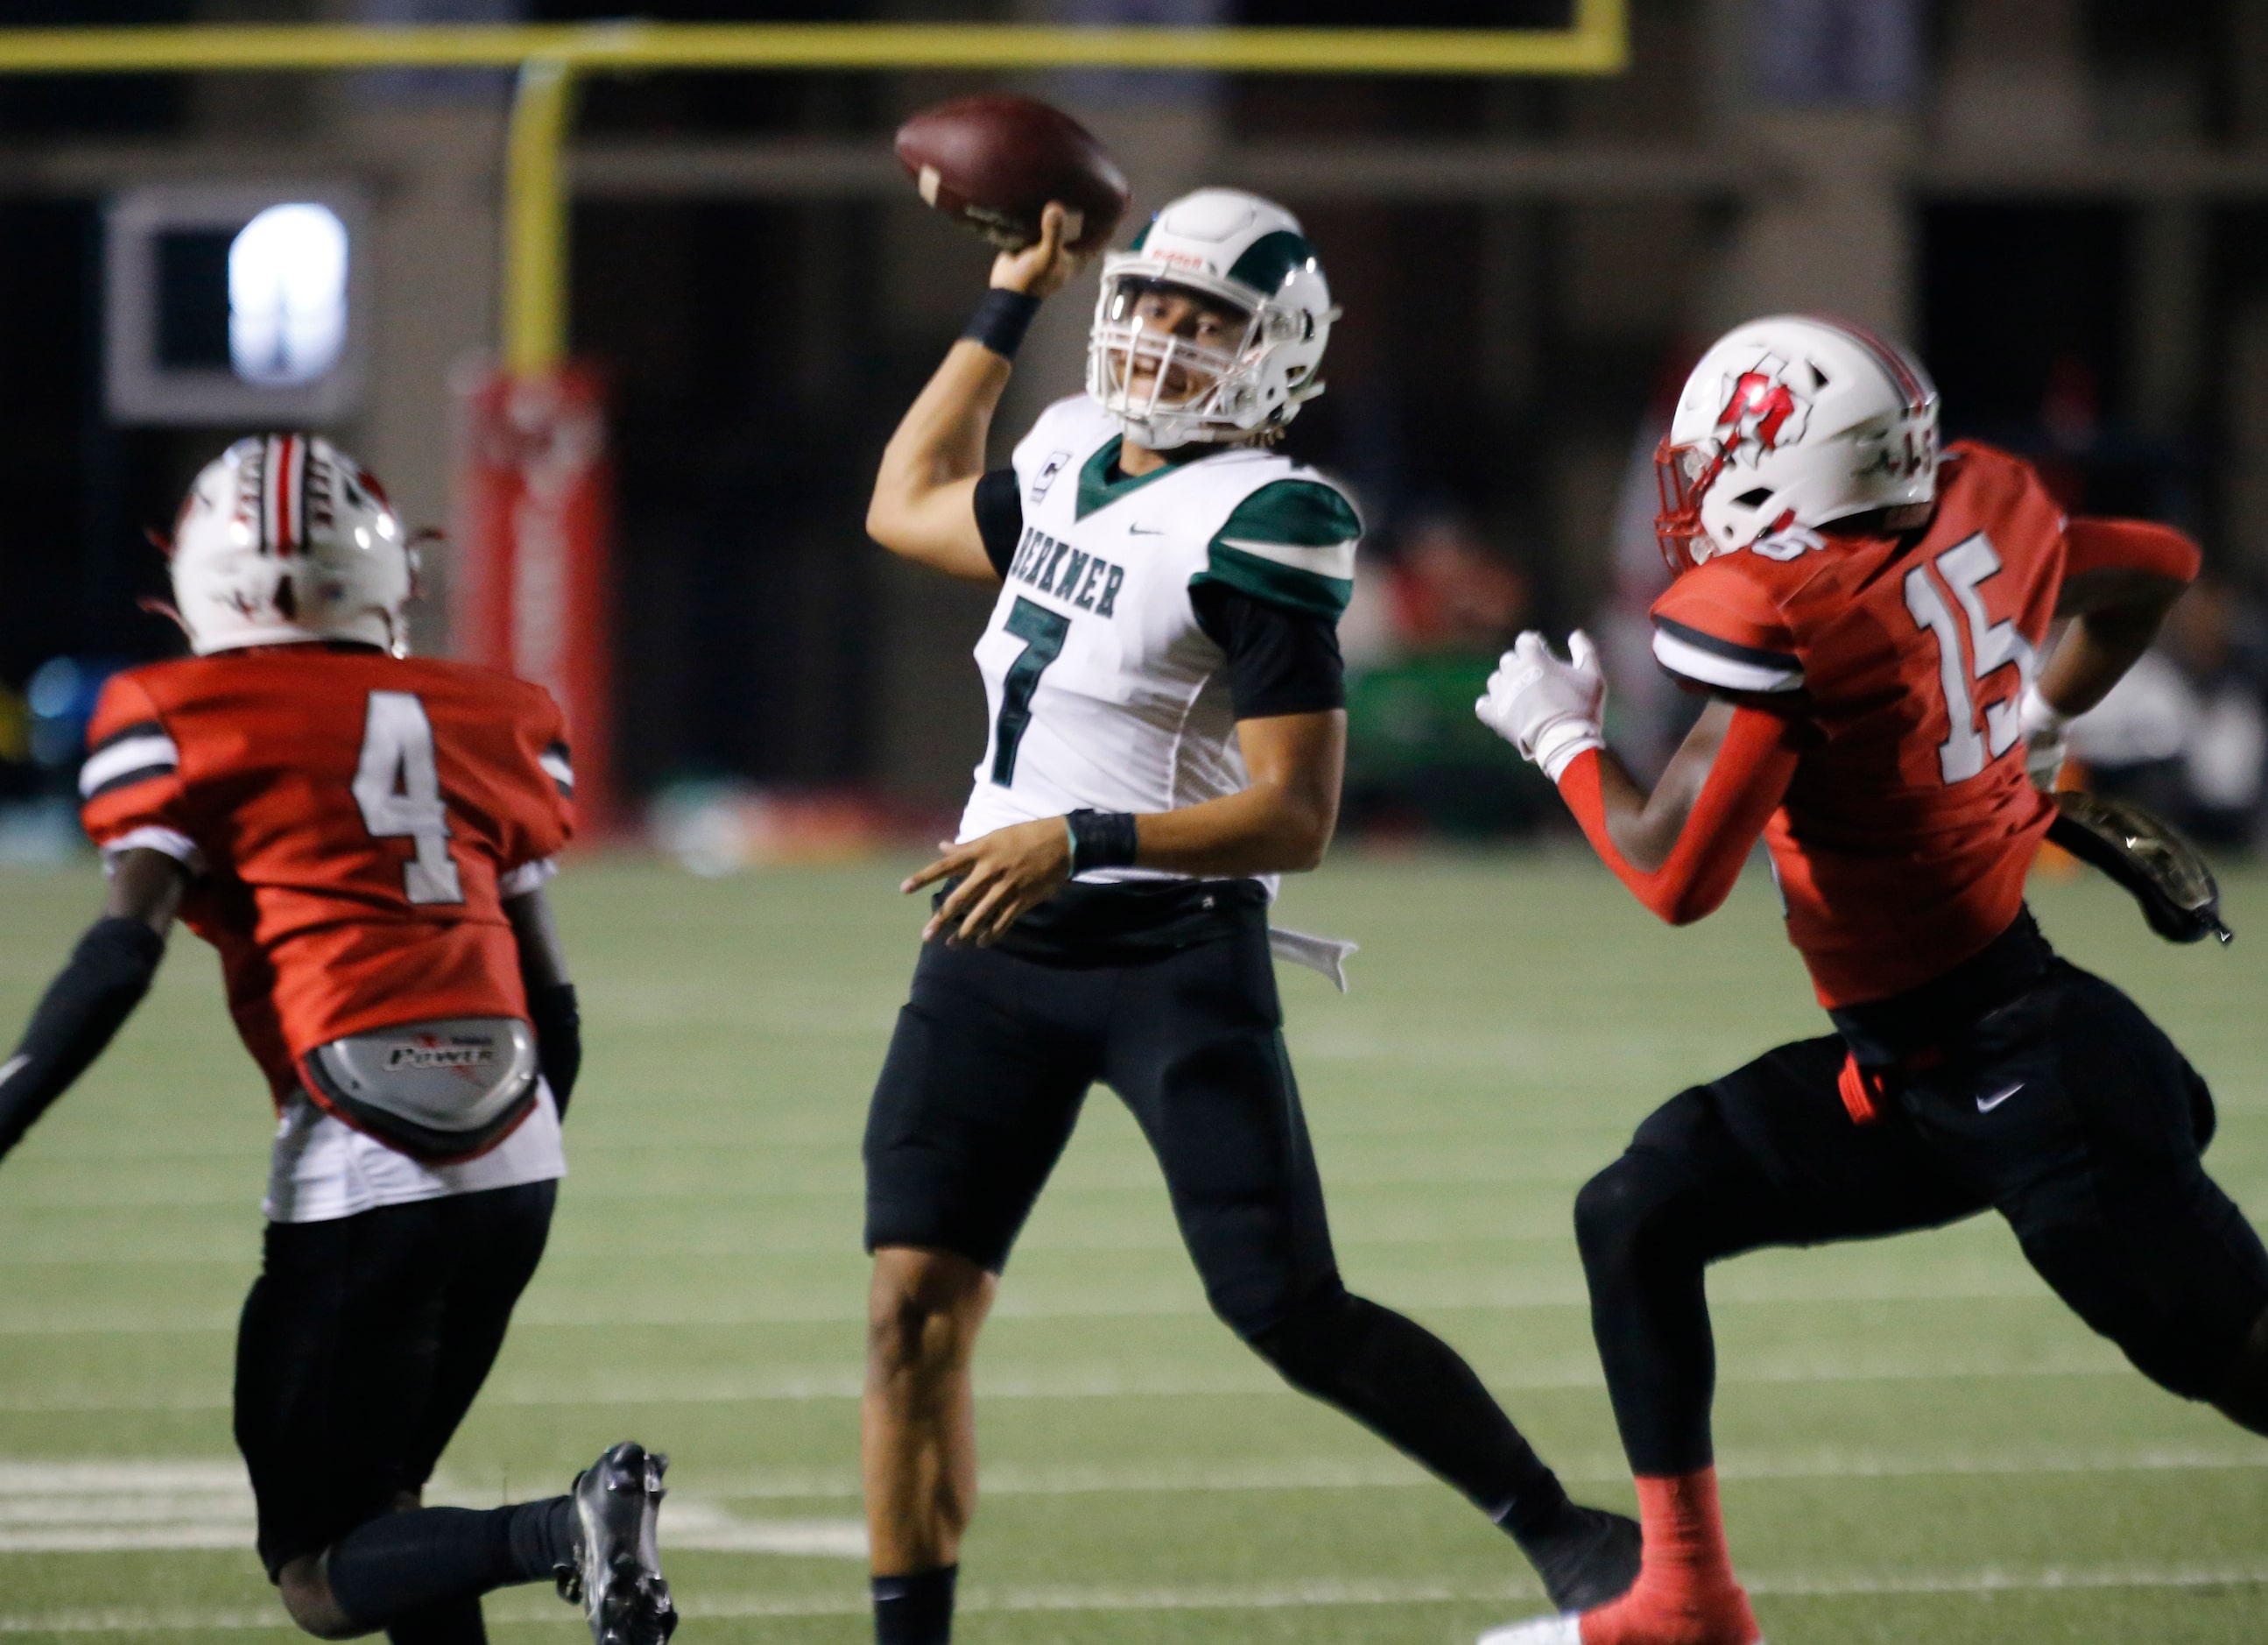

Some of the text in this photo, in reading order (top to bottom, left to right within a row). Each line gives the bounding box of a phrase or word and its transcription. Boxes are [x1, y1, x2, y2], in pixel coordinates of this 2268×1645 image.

[1011, 526, 1124, 618] BERKNER
[1904, 530, 2033, 784] 15
[990, 596, 1071, 788] 7
[352, 689, 464, 904] 4
